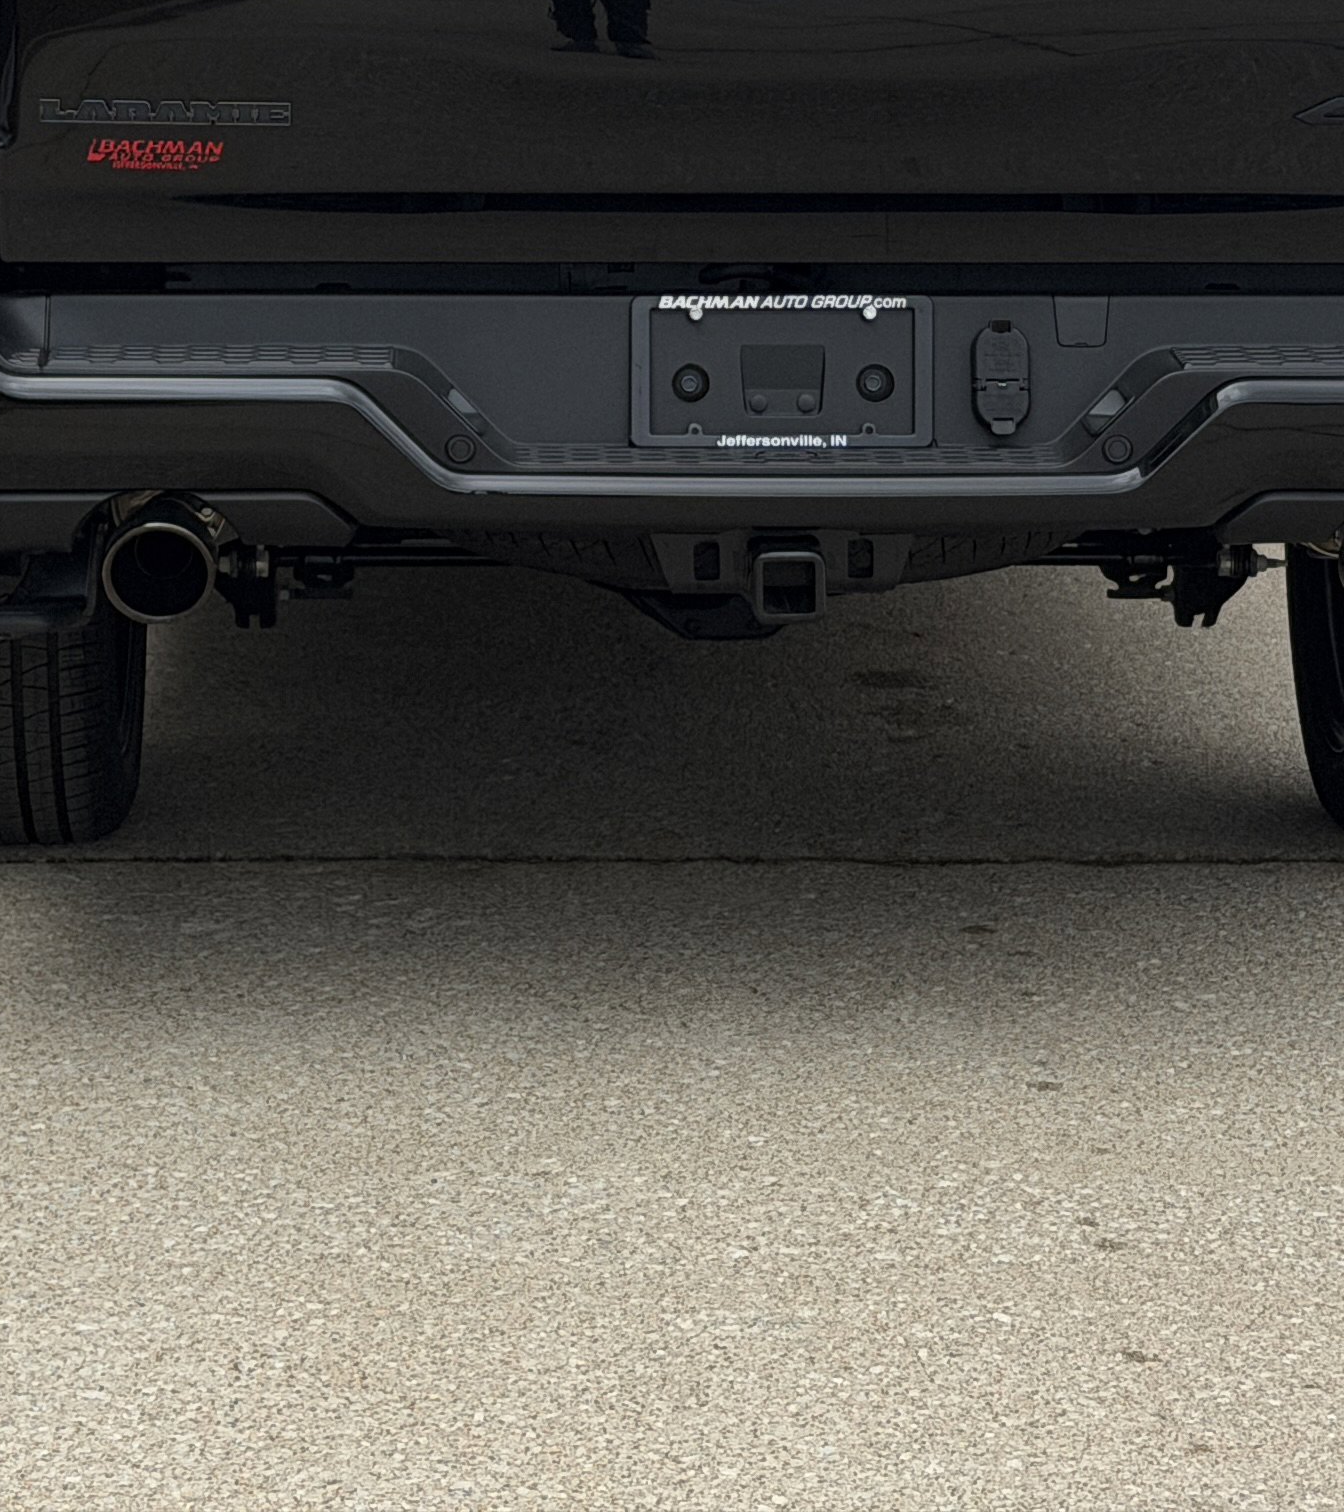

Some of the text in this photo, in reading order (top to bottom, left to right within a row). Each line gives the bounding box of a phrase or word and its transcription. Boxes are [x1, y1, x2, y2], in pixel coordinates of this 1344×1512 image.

[39, 99, 292, 126] LARAMIE
[98, 139, 224, 155] BACHMAN
[658, 295, 760, 309] BACHMAN
[760, 295, 808, 309] AUTO
[717, 434, 847, 448] Jeffersonville, IN
